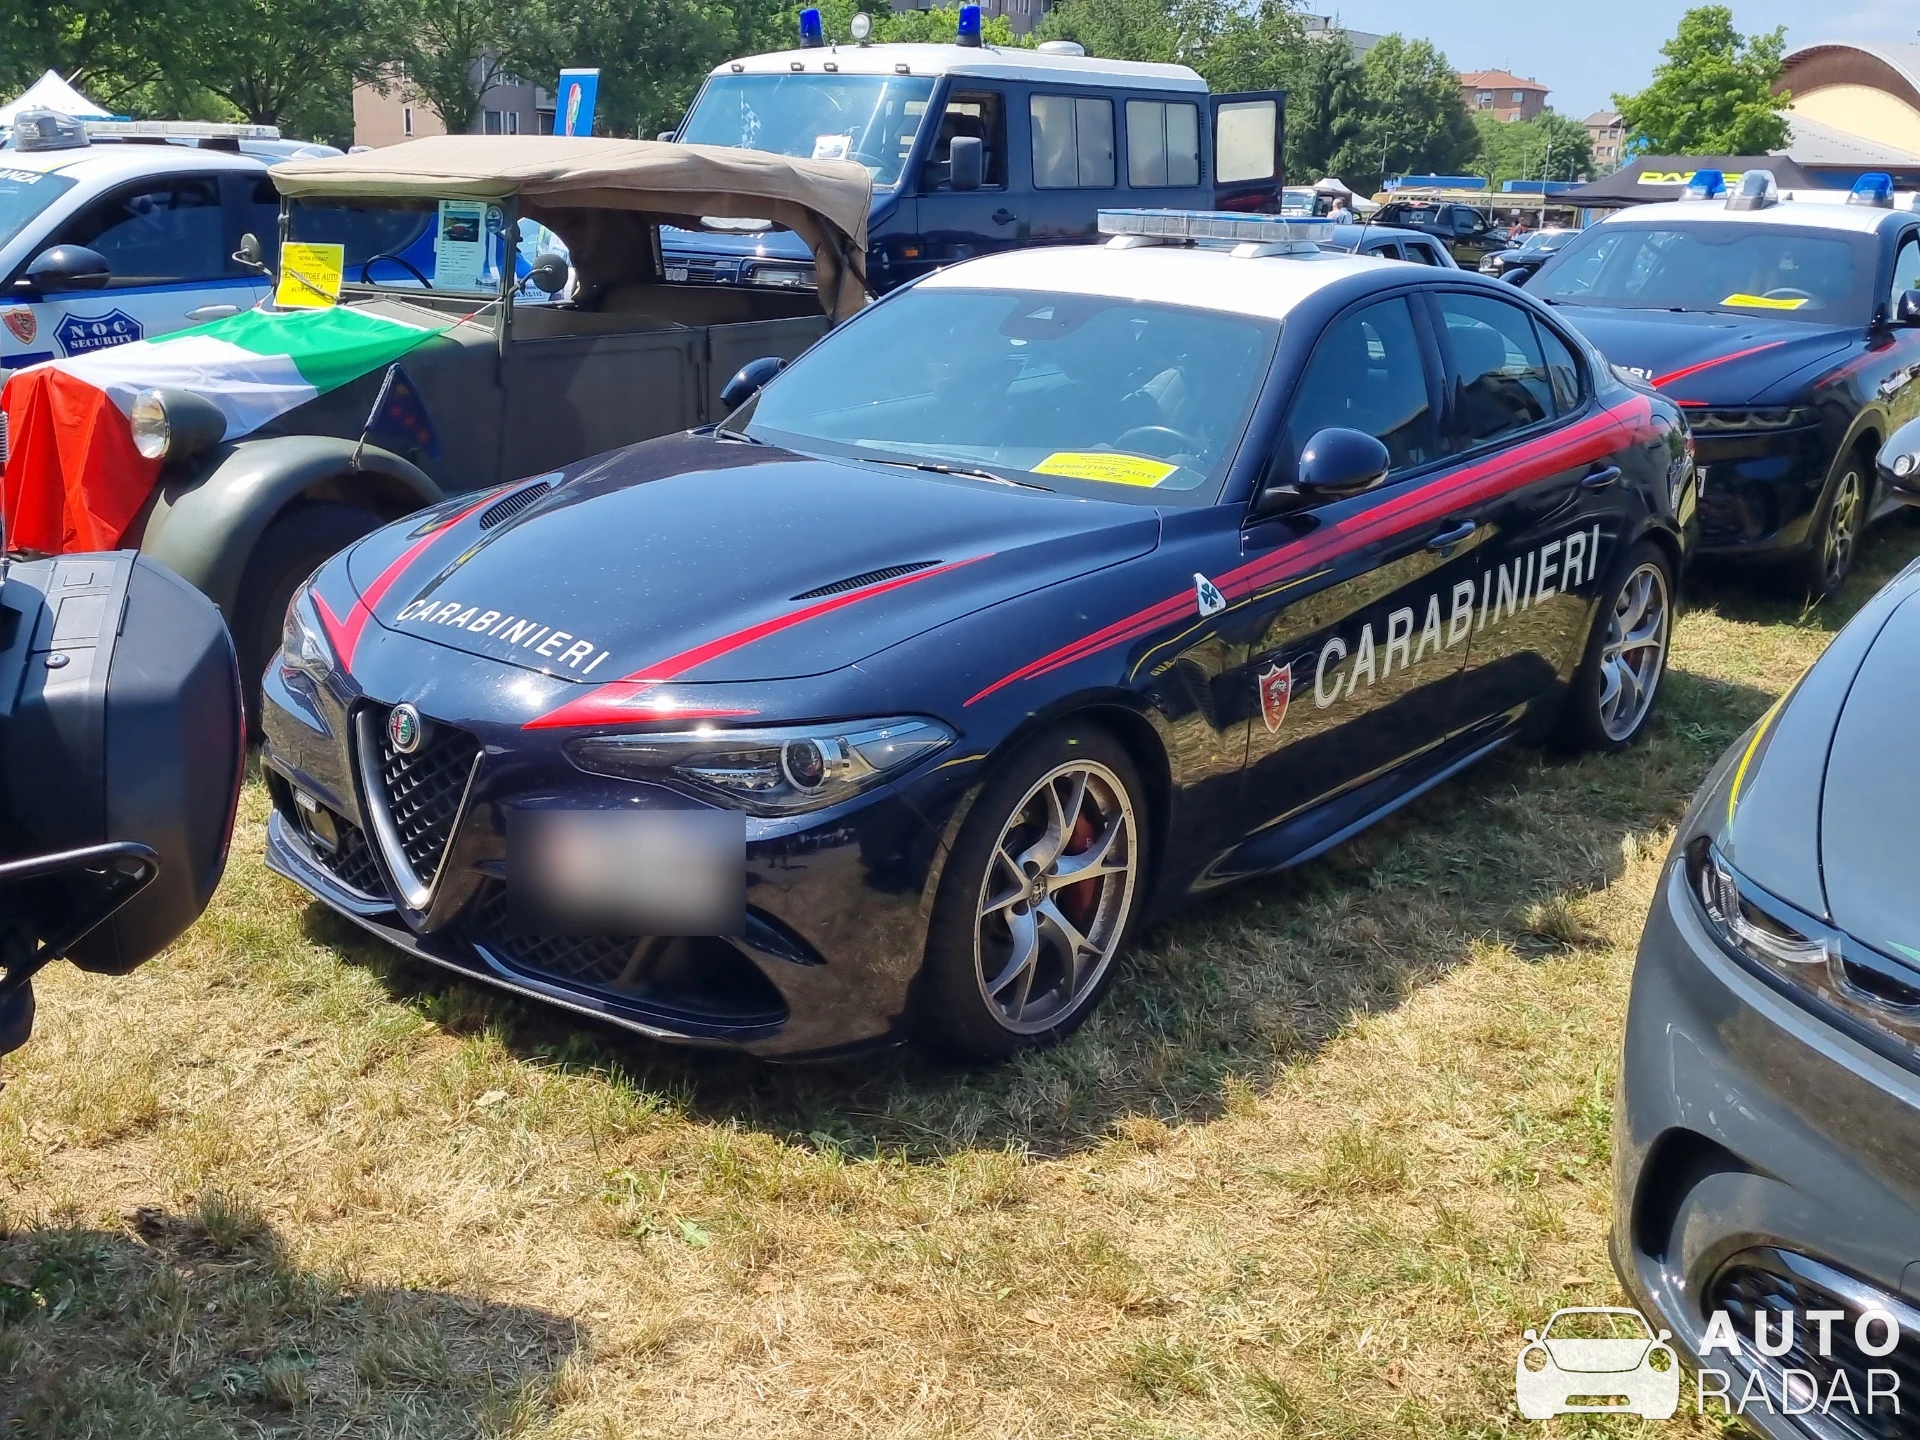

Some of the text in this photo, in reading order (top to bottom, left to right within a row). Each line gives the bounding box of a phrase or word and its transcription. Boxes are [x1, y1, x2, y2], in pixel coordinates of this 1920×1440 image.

[70, 333, 133, 349] SECURITY
[1621, 366, 1653, 380] RI
[1122, 469, 1157, 479] AUTO
[1314, 524, 1600, 710] CARABINIERI
[396, 600, 610, 674] CARABINIERI
